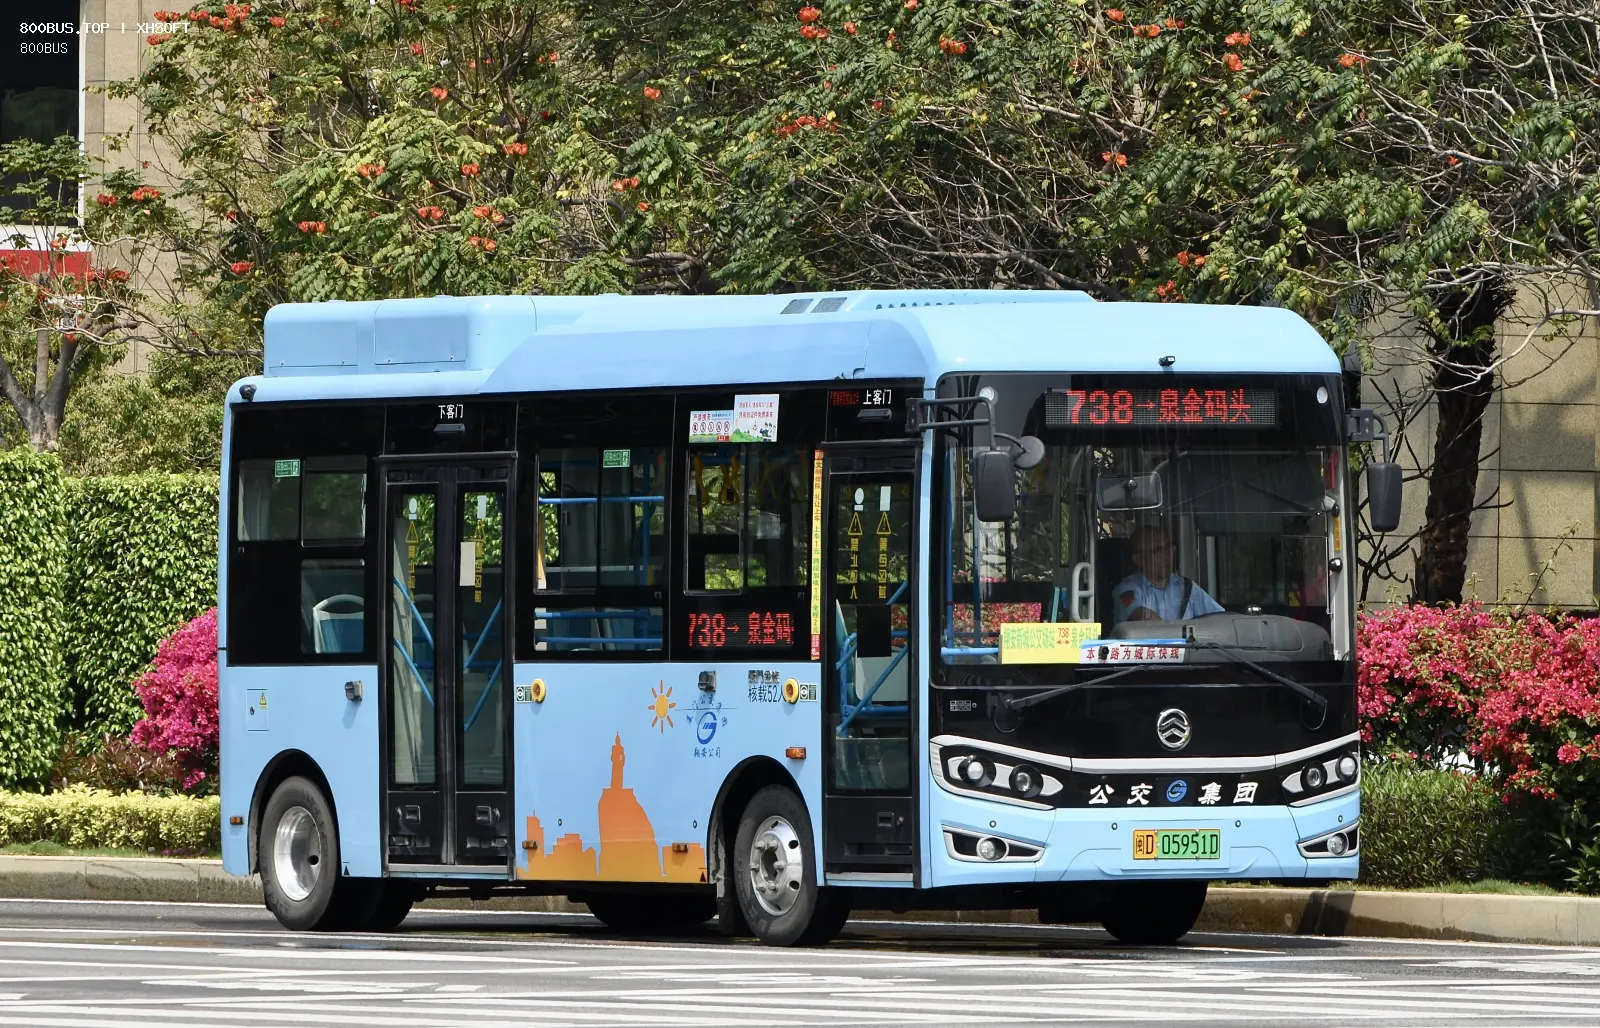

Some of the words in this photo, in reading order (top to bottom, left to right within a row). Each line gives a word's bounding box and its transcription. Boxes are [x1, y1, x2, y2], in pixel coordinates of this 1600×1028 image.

[863, 389, 892, 405] 上客门
[1067, 390, 1134, 424] 738
[1158, 388, 1252, 423] 泉金码头
[438, 404, 464, 420] 下客门
[688, 613, 726, 647] 738
[748, 611, 794, 645] 泉金码
[1058, 627, 1070, 638] 738
[693, 746, 721, 759] 翔安公司
[1088, 782, 1153, 806] 公交
[1197, 781, 1259, 806] 集团
[1161, 834, 1219, 855] 05951D
